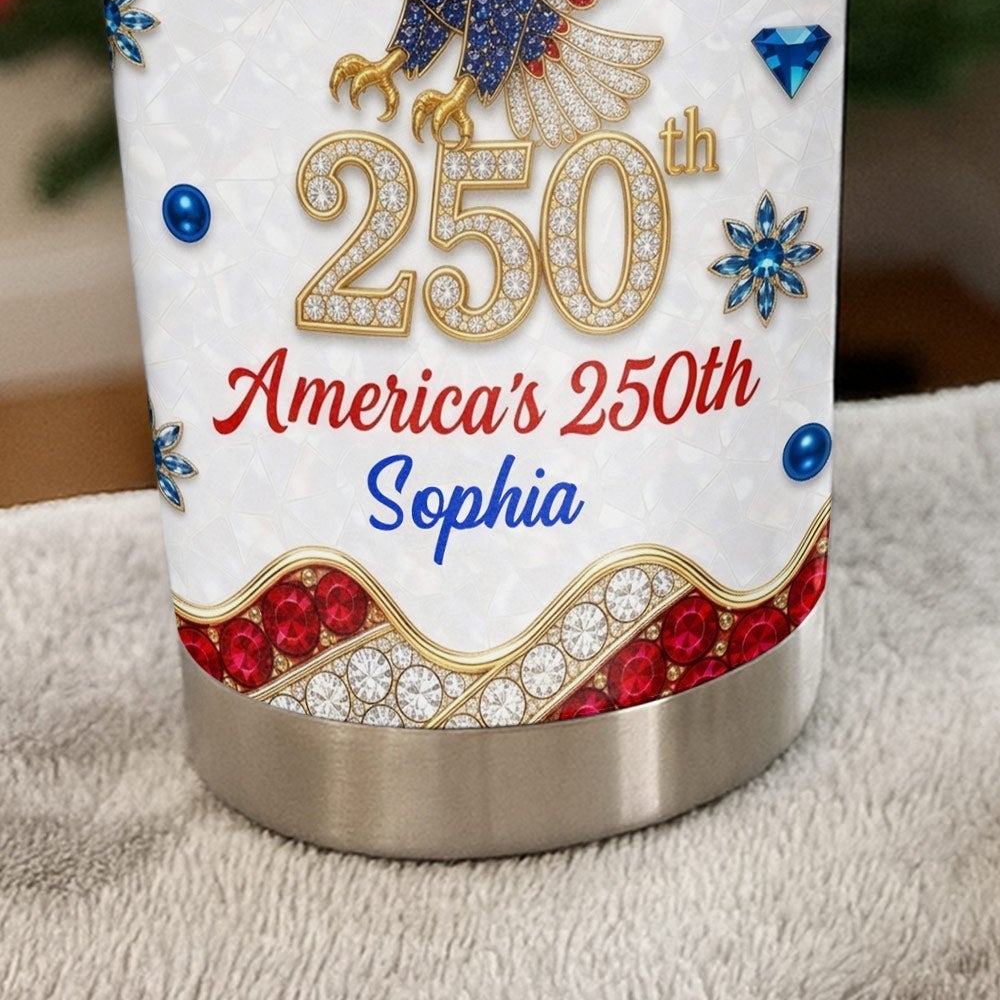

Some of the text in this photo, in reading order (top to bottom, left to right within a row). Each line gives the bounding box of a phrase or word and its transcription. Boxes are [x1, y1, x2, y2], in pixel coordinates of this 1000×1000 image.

[296, 105, 720, 342] 250th
[213, 338, 760, 436] America's 250th
[366, 453, 585, 565] Sophia
